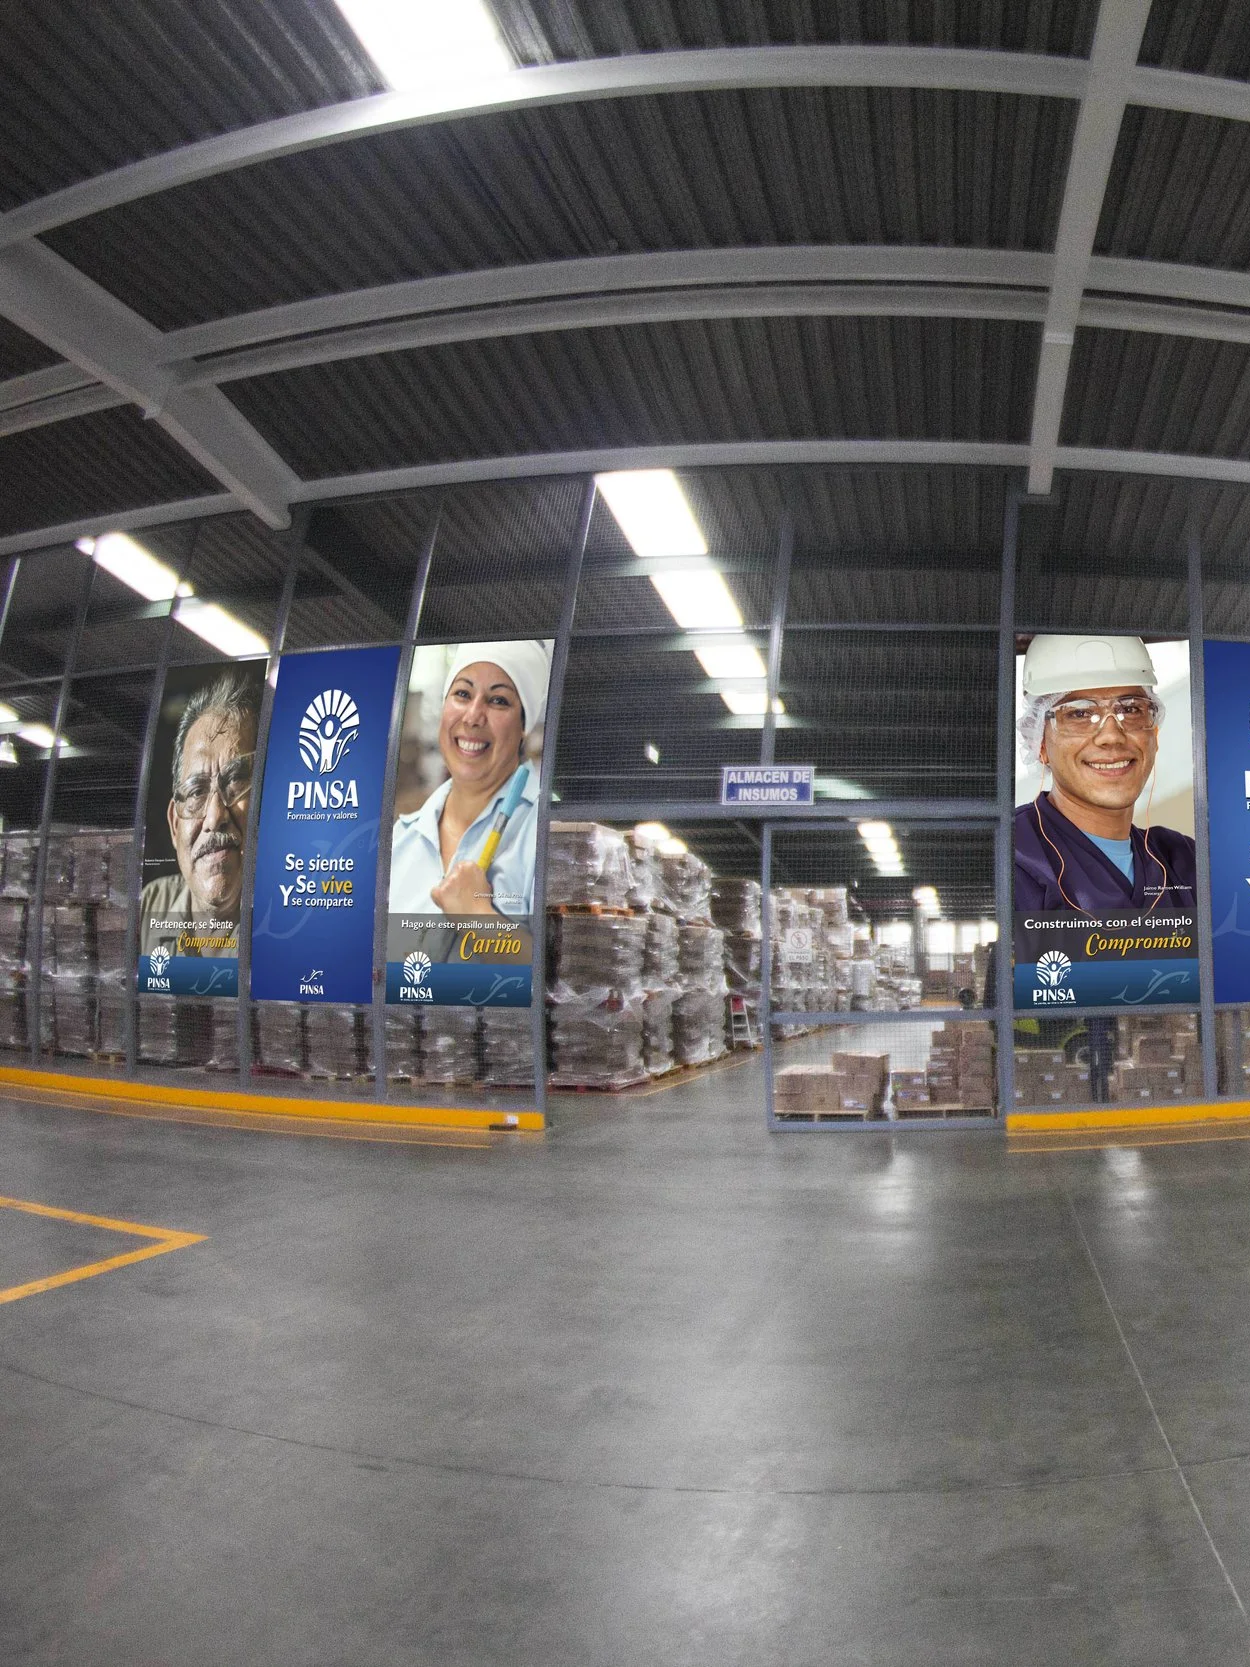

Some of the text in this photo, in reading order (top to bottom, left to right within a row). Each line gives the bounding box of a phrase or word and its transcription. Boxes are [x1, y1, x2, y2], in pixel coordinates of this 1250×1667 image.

[728, 771, 810, 784] ALMACEN DE
[287, 780, 359, 809] PINSA
[738, 788, 798, 800] INSUMOS
[287, 811, 358, 822] Formación y valores
[285, 853, 354, 871] Se siente
[296, 875, 353, 894] Se vive
[279, 884, 354, 910] Y se comparte
[150, 918, 234, 930] Pertenecer, se Siente
[401, 920, 423, 930] Hago
[426, 920, 436, 929] de
[438, 921, 456, 929] este
[458, 920, 483, 931] pasillo
[496, 921, 520, 932] hogar
[1024, 916, 1193, 930] Construimos con el ejemplo
[177, 932, 237, 953] Compromiso
[459, 930, 522, 960] Cariño
[1085, 932, 1192, 956] Compromiso
[147, 978, 170, 988] PINSA
[300, 984, 324, 995] PINSA
[400, 986, 433, 999] PINSA
[1032, 988, 1076, 1002] PINSA
